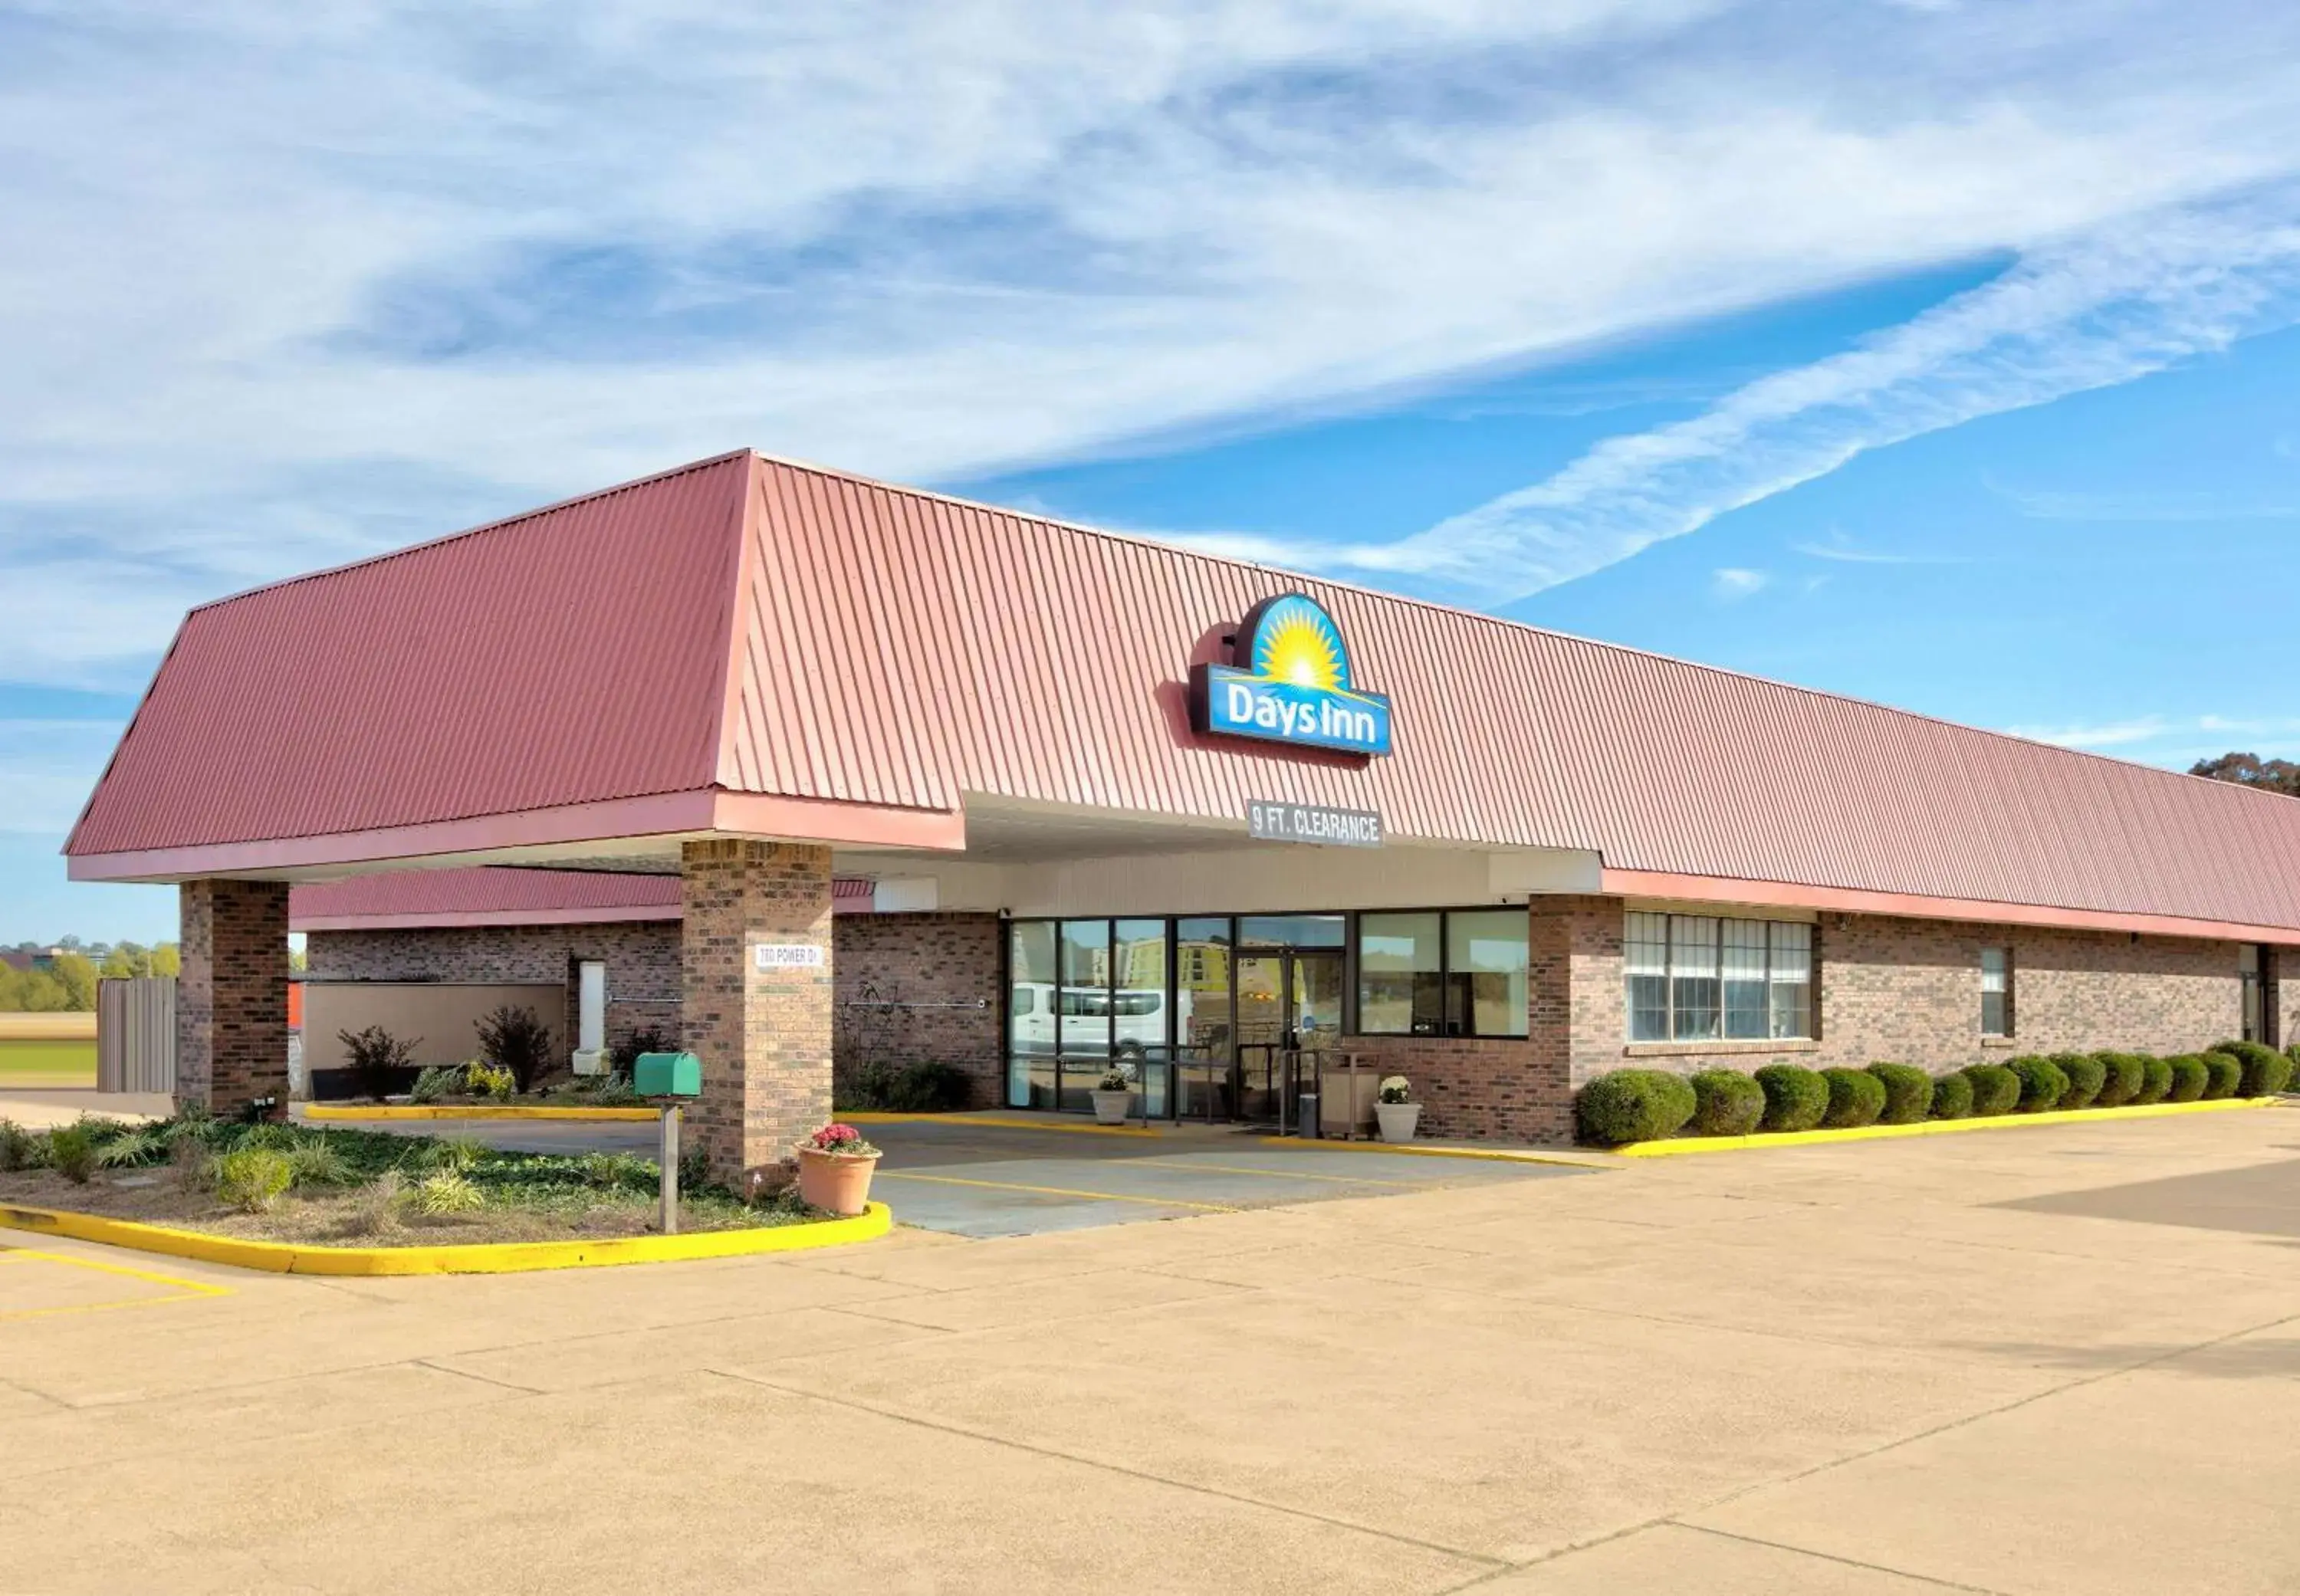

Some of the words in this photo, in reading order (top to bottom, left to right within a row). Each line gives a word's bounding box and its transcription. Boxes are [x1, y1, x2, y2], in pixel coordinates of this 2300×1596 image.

[1228, 684, 1316, 736] Days
[1322, 699, 1375, 743] Inn
[1252, 806, 1263, 832] 9
[1267, 807, 1291, 833] FT.
[1294, 809, 1379, 842] CLEARANCE
[777, 947, 806, 964] POWER
